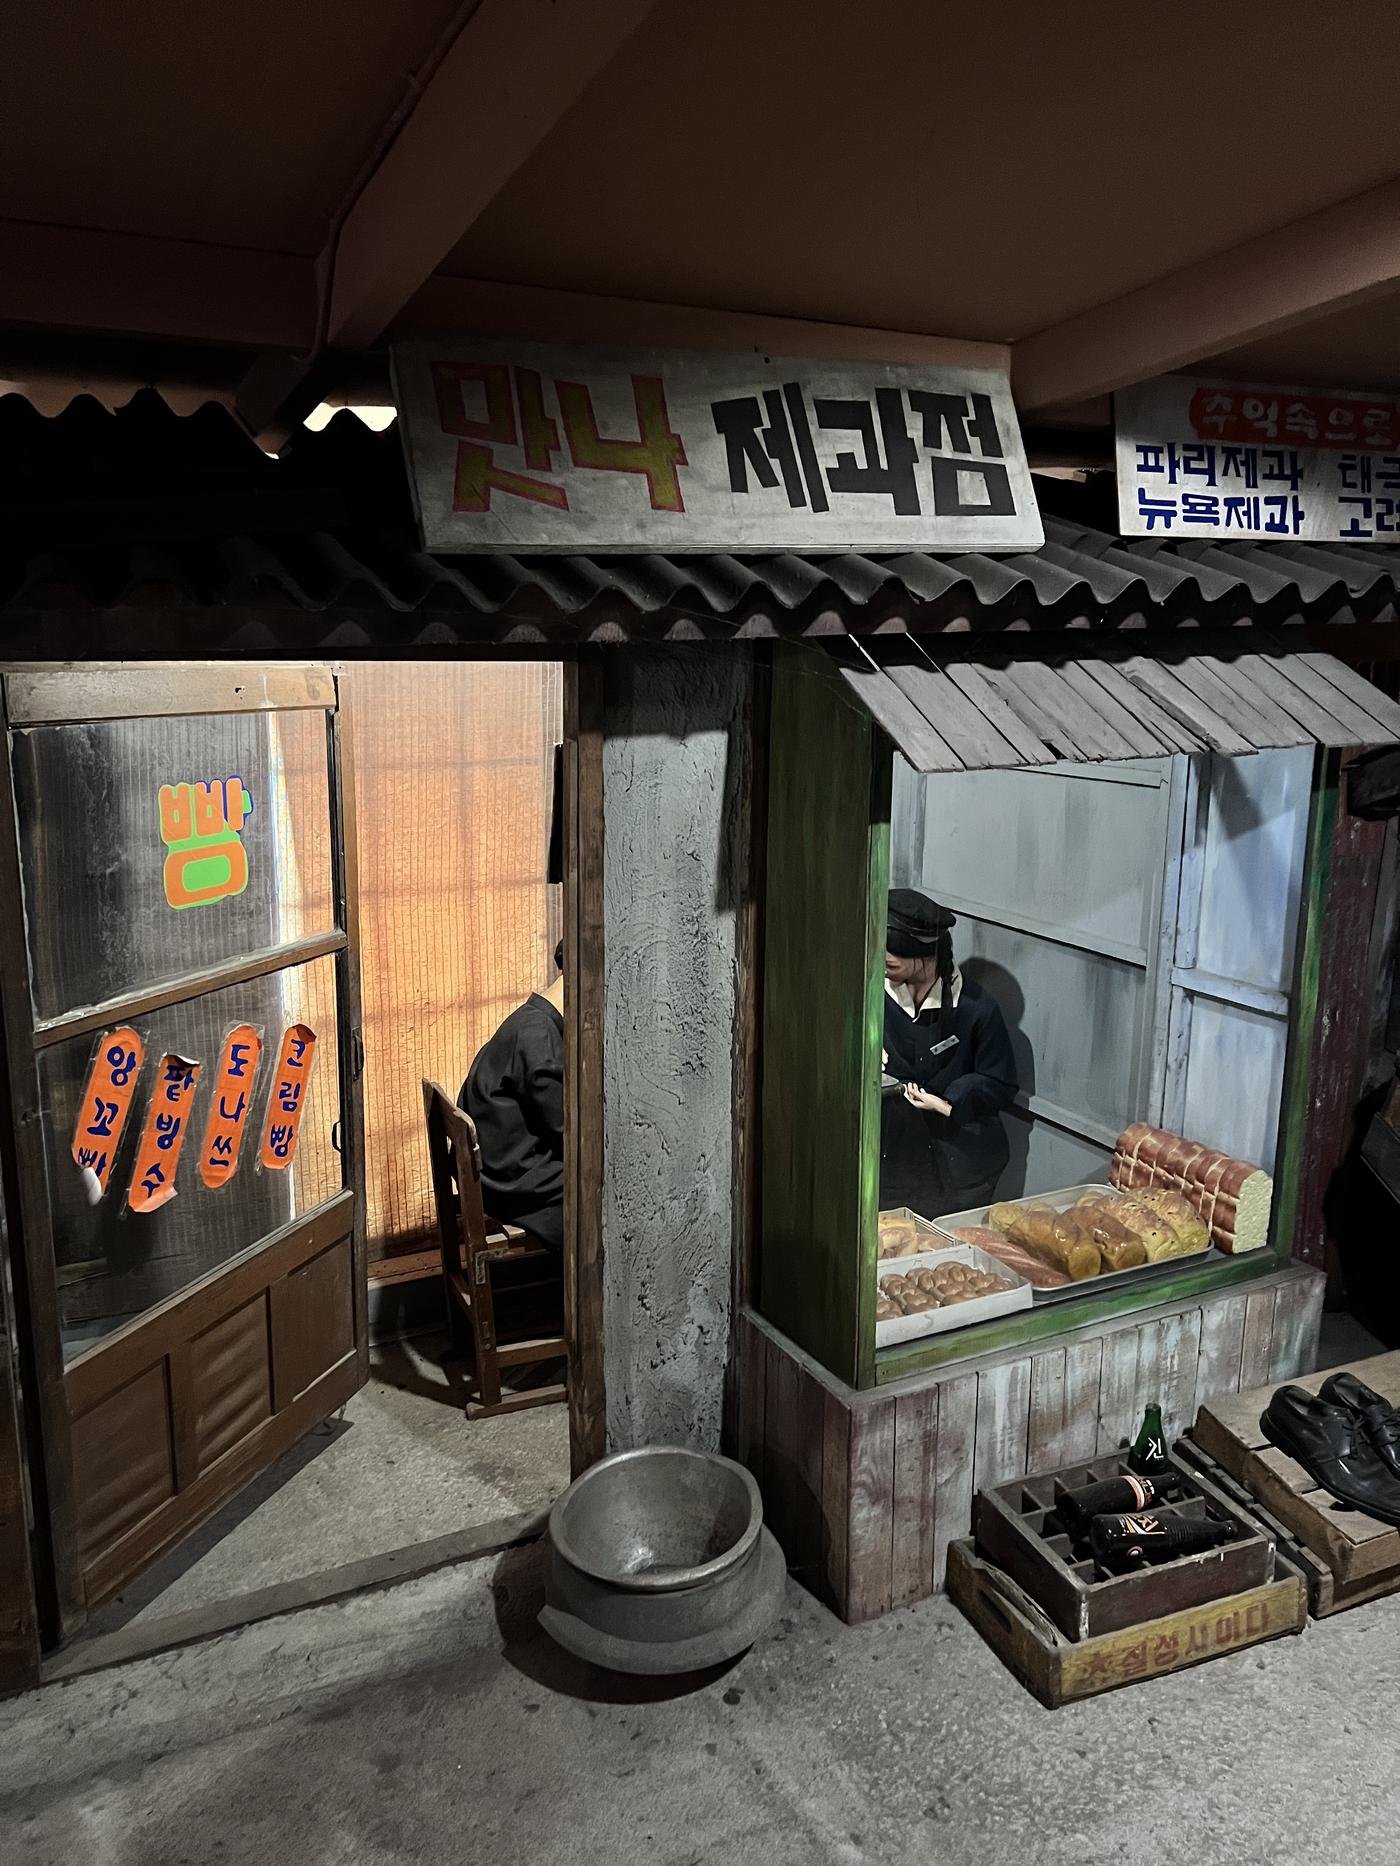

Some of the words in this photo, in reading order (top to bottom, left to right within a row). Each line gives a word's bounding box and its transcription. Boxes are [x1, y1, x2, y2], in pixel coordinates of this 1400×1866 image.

[710, 382, 1017, 516] 제과점
[1135, 442, 1304, 491] 파리제과
[1137, 487, 1305, 536] 뉴욕제과
[158, 775, 254, 909] 빵
[141, 1064, 194, 1198] 팥빙수
[208, 1043, 250, 1167] 도나쓰
[270, 1038, 306, 1158] 크림빵
